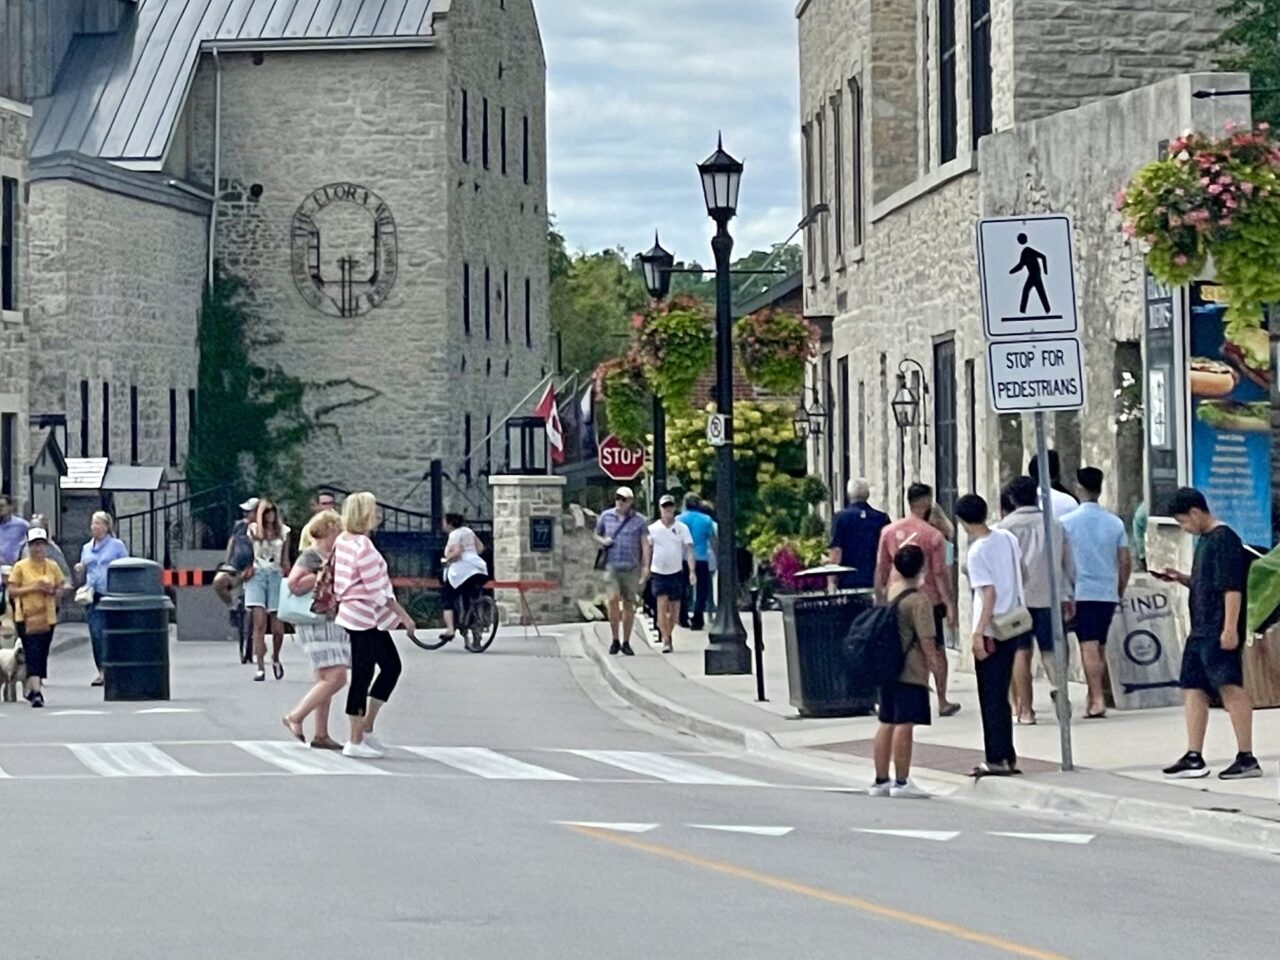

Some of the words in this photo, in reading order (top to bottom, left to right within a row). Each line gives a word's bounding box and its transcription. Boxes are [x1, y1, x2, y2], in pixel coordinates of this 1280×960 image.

[1006, 351, 1035, 369] STOP
[1041, 349, 1064, 367] FOR
[997, 378, 1078, 399] PEDESTRIANS
[602, 447, 642, 465] STOP
